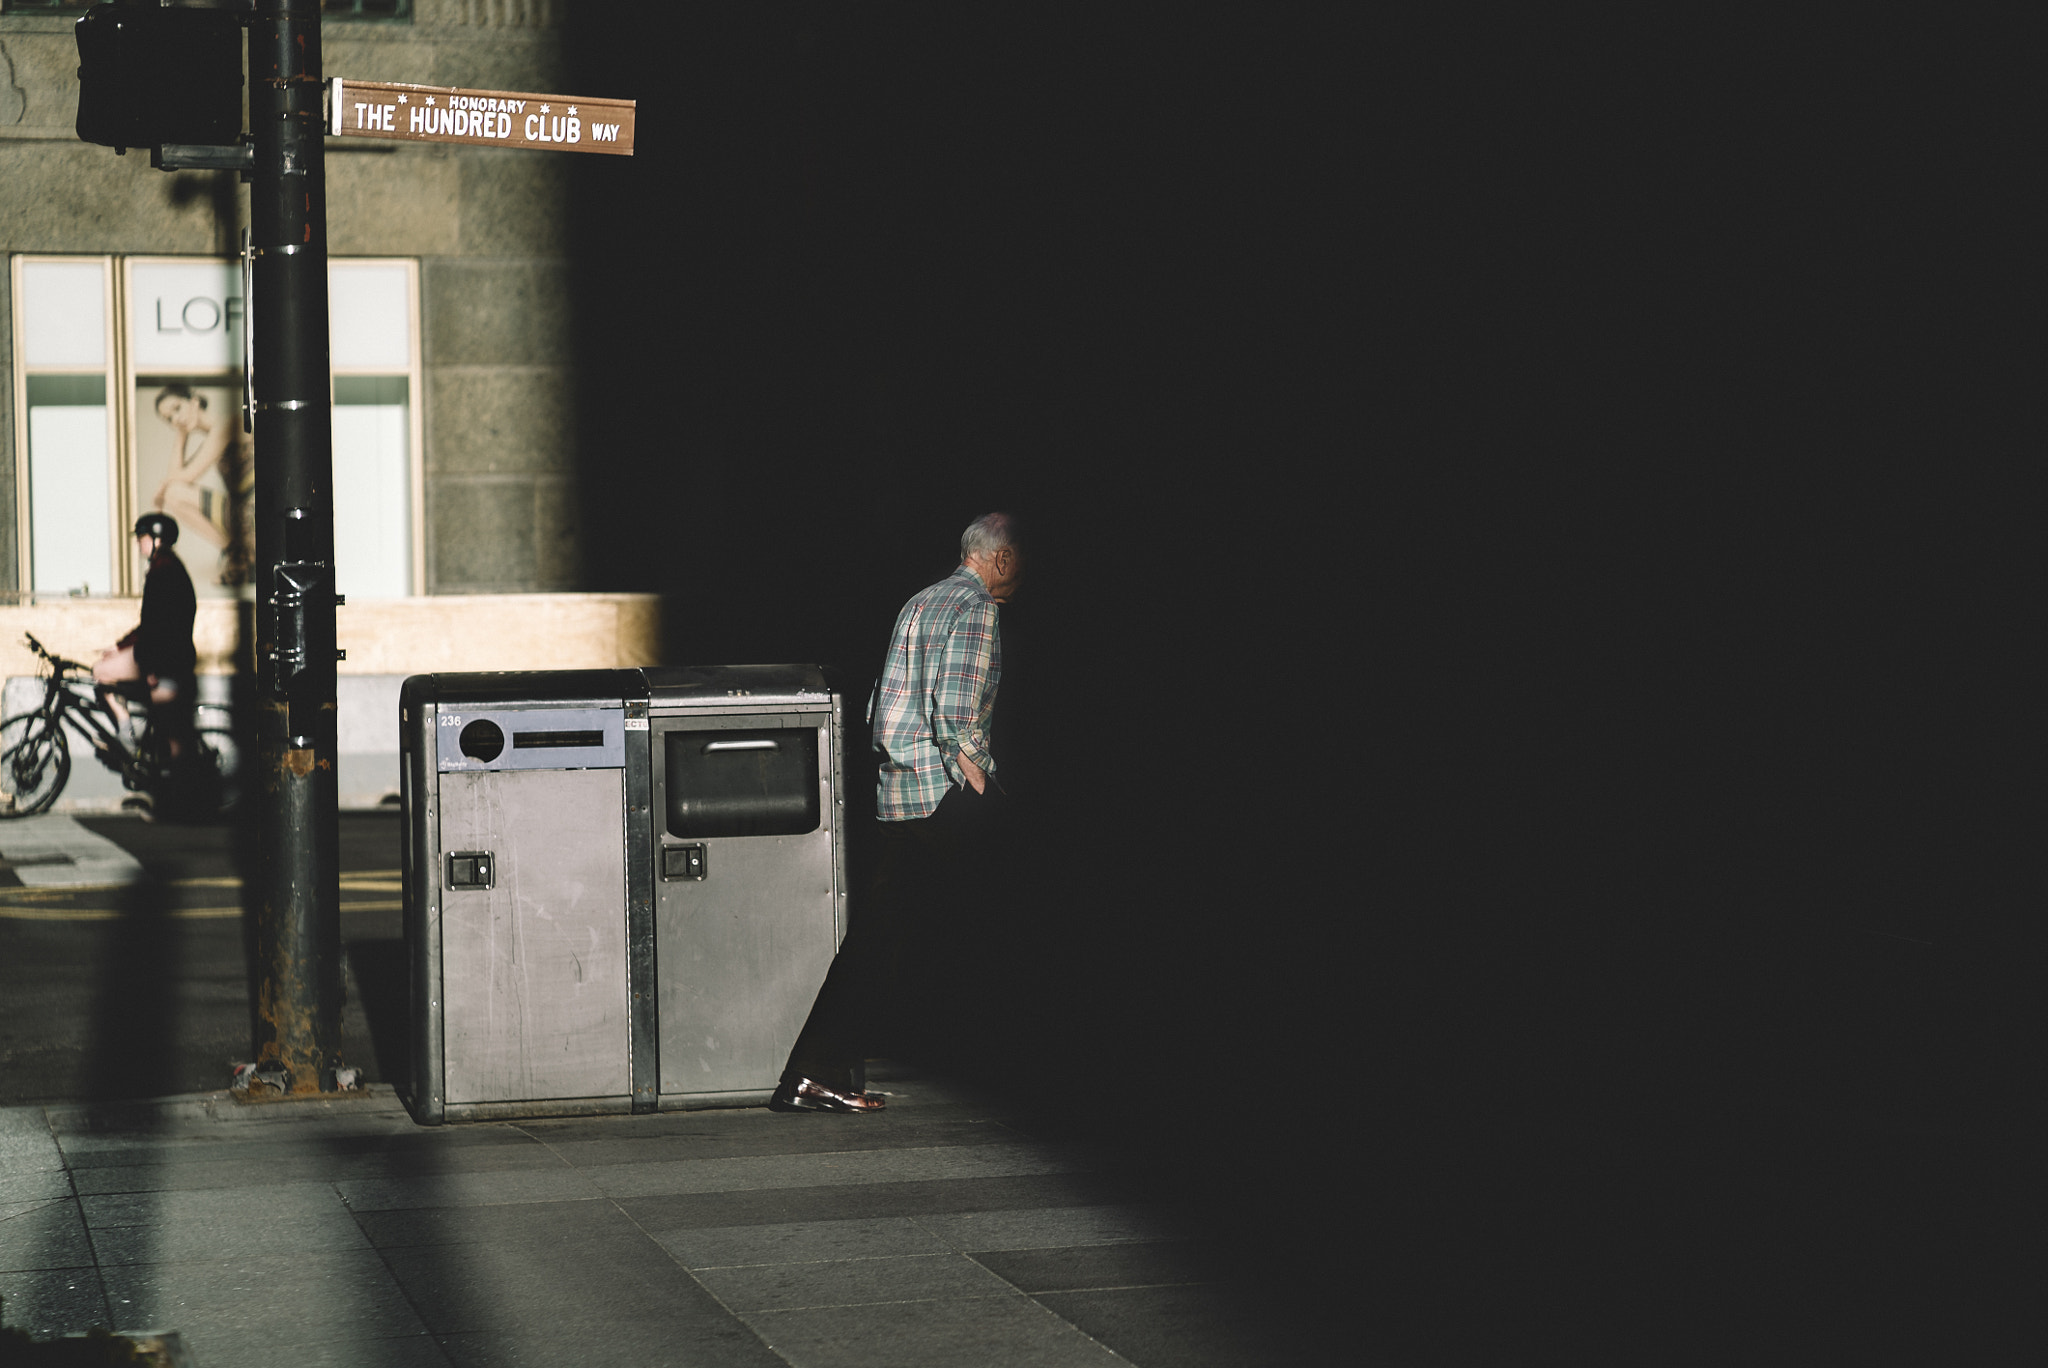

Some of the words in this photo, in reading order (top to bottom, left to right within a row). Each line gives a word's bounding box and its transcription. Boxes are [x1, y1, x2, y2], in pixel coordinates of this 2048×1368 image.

[449, 96, 527, 113] HONORARY
[355, 103, 396, 131] THE
[410, 107, 512, 139] HUNDRED
[525, 114, 581, 143] CLUB
[592, 123, 620, 142] WAY
[441, 715, 461, 727] 236
